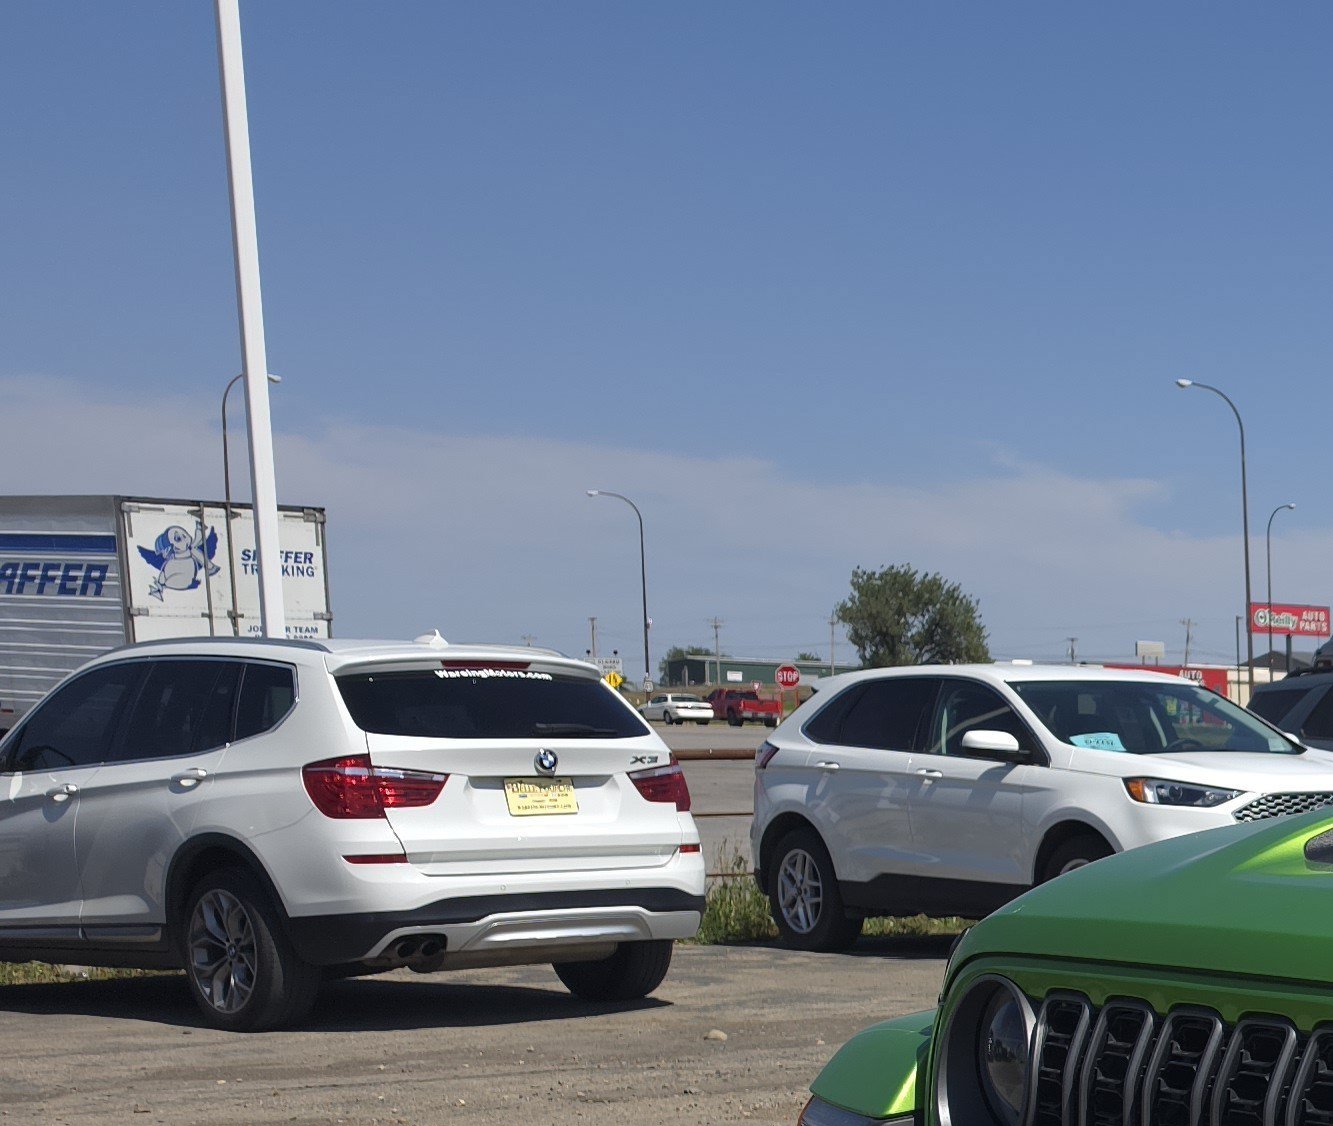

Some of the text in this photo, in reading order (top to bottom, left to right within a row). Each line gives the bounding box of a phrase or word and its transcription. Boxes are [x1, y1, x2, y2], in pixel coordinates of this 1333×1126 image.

[1302, 610, 1325, 621] AUTO
[294, 626, 319, 634] TEAM
[1300, 620, 1328, 632] PARTS
[778, 670, 799, 682] STOP
[629, 755, 659, 765] X3
